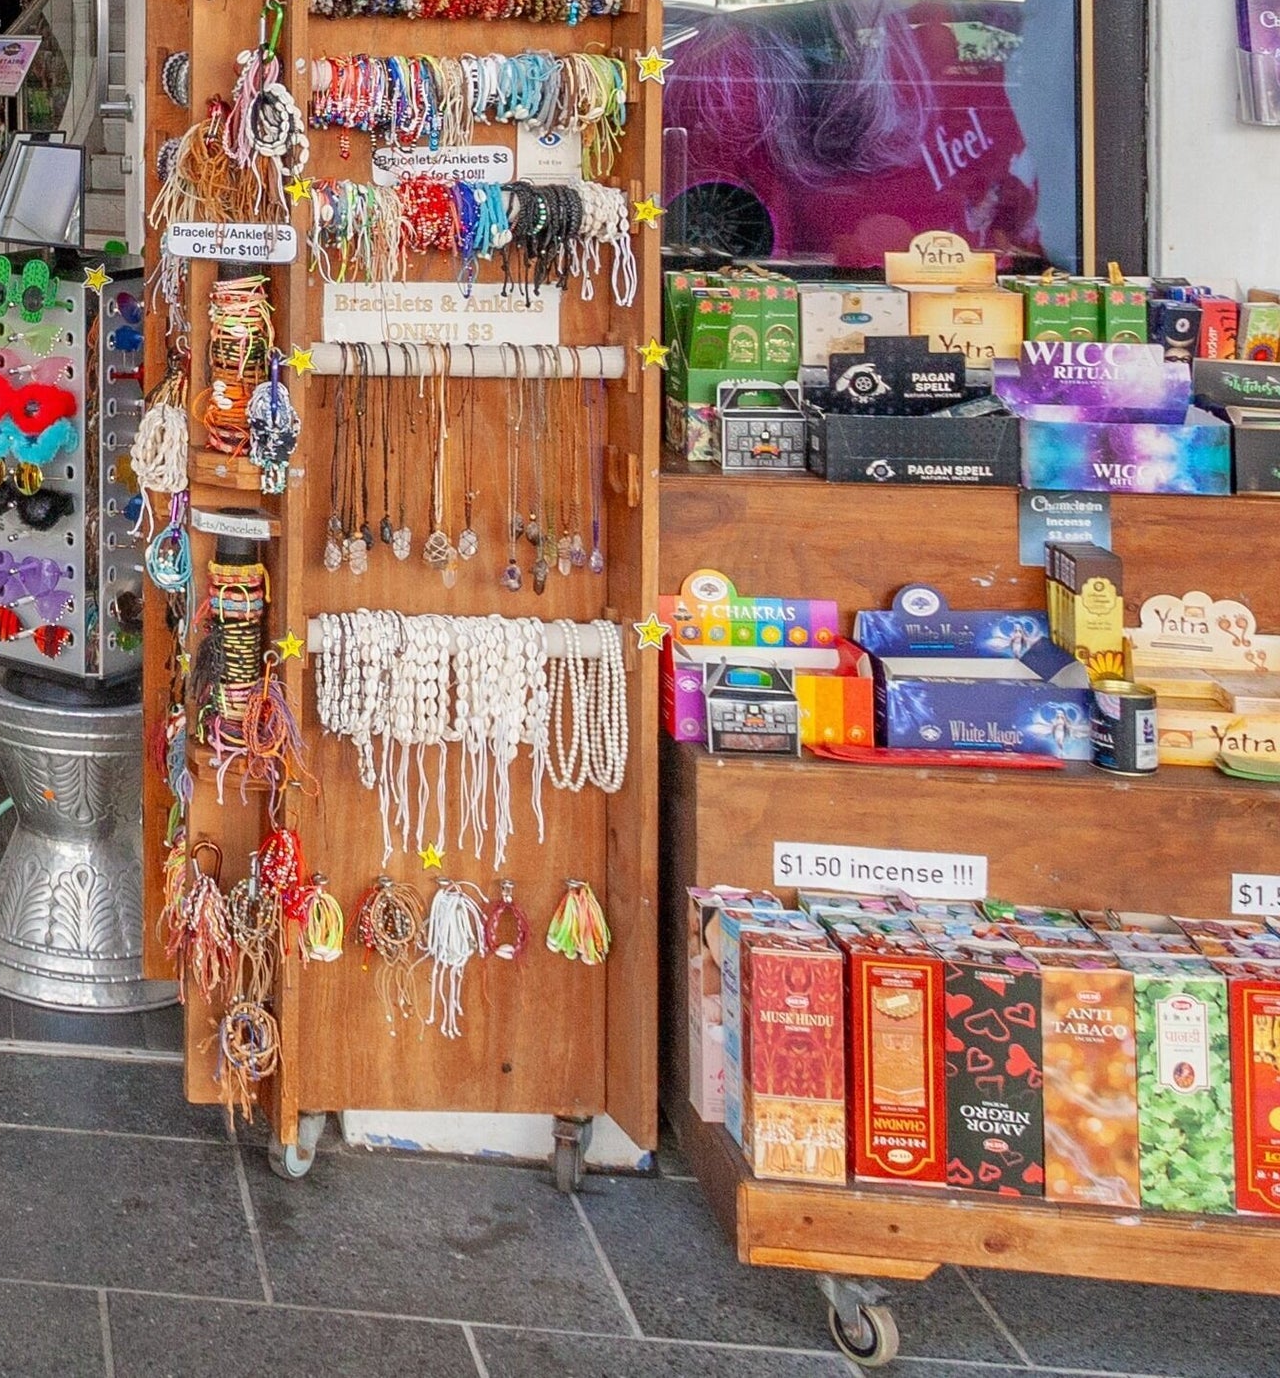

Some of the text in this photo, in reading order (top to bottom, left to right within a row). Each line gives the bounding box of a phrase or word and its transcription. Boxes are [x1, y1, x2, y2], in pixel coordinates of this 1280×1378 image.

[936, 107, 993, 177] feel.
[492, 152, 508, 165] $3
[277, 228, 292, 242] $3
[192, 243, 207, 255] Or
[208, 244, 216, 255] 5
[915, 244, 965, 266] Yatra
[334, 295, 544, 314] Bracelets & Anklets
[389, 323, 493, 341] ONLY!! $3
[911, 372, 955, 382] PAGAN
[915, 383, 952, 392] SPELL
[907, 464, 993, 476] PAGAN SPELL
[1046, 517, 1092, 527] Incense
[1048, 530, 1093, 541] $3 each
[696, 604, 796, 621] 7 CHAKRAS
[1154, 608, 1210, 634] Yatra
[905, 623, 975, 643] White Magic
[949, 720, 1024, 744] White Magic
[1210, 725, 1277, 754] Yatra
[779, 853, 974, 886] $1.50 incense !!!
[760, 1010, 834, 1027] MUSK HINDU
[1066, 1008, 1113, 1021] ANTI
[1053, 1022, 1127, 1039] TABACO
[959, 1104, 1031, 1126] NEGRO
[873, 1117, 925, 1133] CHANDAN
[966, 1117, 1027, 1137] AMOR
[873, 1135, 927, 1148] PRECIOUS
